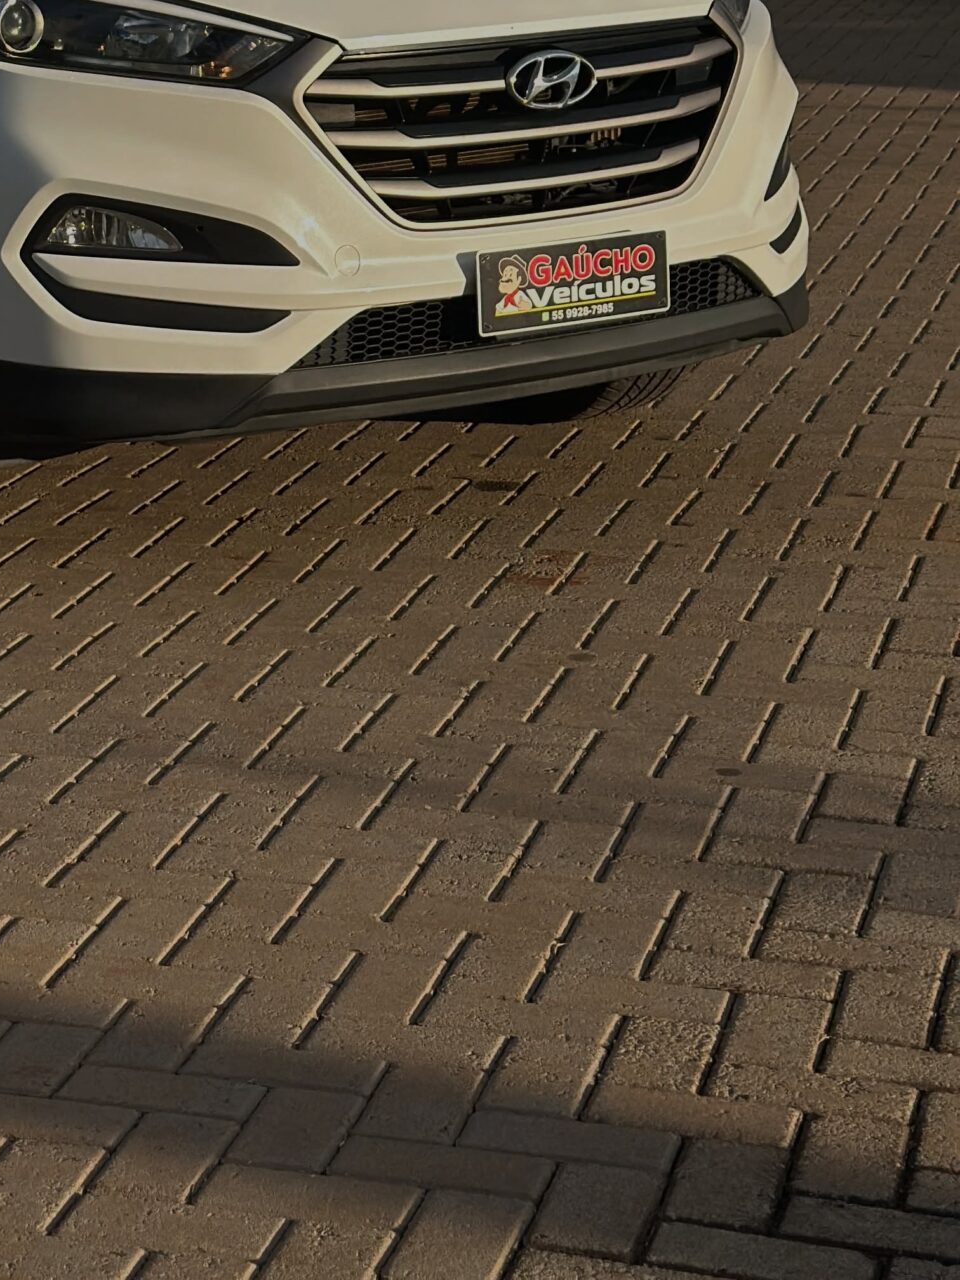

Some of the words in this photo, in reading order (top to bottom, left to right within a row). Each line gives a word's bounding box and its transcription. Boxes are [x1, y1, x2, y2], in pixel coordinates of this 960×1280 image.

[527, 244, 656, 287] GAÚCHO
[527, 274, 656, 307] Veículos
[551, 310, 564, 321] 55
